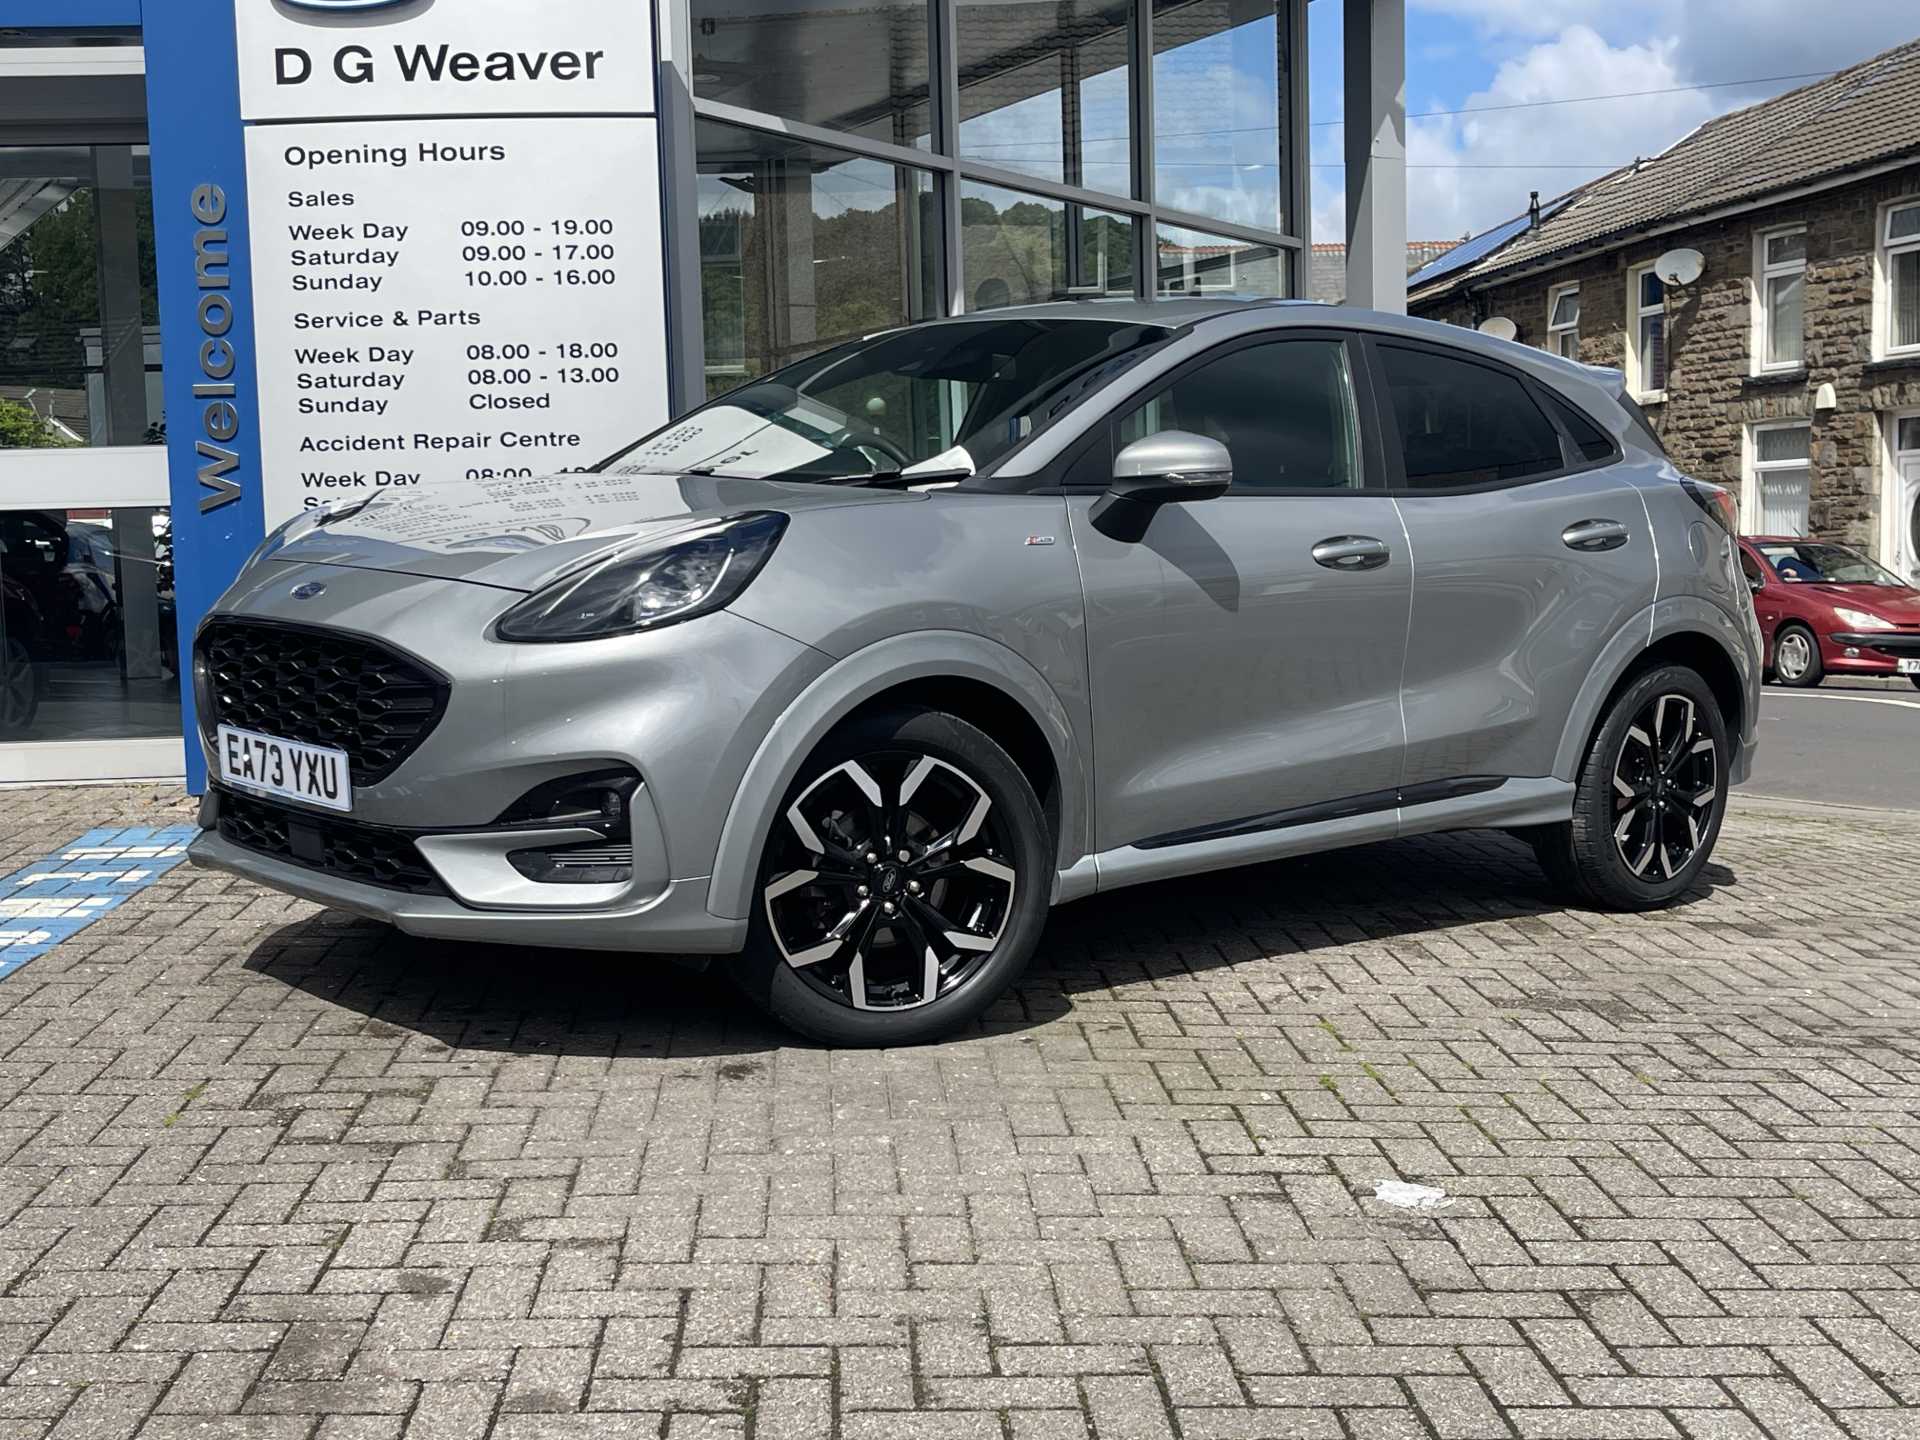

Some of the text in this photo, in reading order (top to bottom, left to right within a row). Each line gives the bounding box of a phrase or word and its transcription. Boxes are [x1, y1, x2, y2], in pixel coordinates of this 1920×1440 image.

[274, 43, 604, 85] D G Weaver
[284, 142, 506, 170] Opening Hours
[287, 190, 355, 208] Sales
[288, 223, 409, 243] Week Day
[460, 219, 526, 238] 09.00
[550, 219, 614, 236] 19.00
[290, 248, 399, 268] Saturday
[462, 245, 527, 263] 09.00
[551, 243, 615, 261] 17.00
[292, 273, 383, 293] Sunday
[464, 270, 528, 287] 10.00
[553, 268, 616, 286] 16.00
[294, 309, 482, 330] Service & Parts
[190, 184, 242, 515] Welcome
[294, 346, 414, 366] Week Day
[466, 343, 531, 362] 08.00
[555, 342, 619, 360] 18.00
[297, 371, 406, 391] Saturday
[467, 368, 532, 386] 08.00
[557, 366, 620, 384] 13.00
[298, 396, 389, 416] Sunday
[469, 392, 551, 411] Closed
[299, 430, 581, 454] Accident Repair Centre
[300, 471, 367, 489] Week
[226, 732, 339, 800] EA73 YXU
